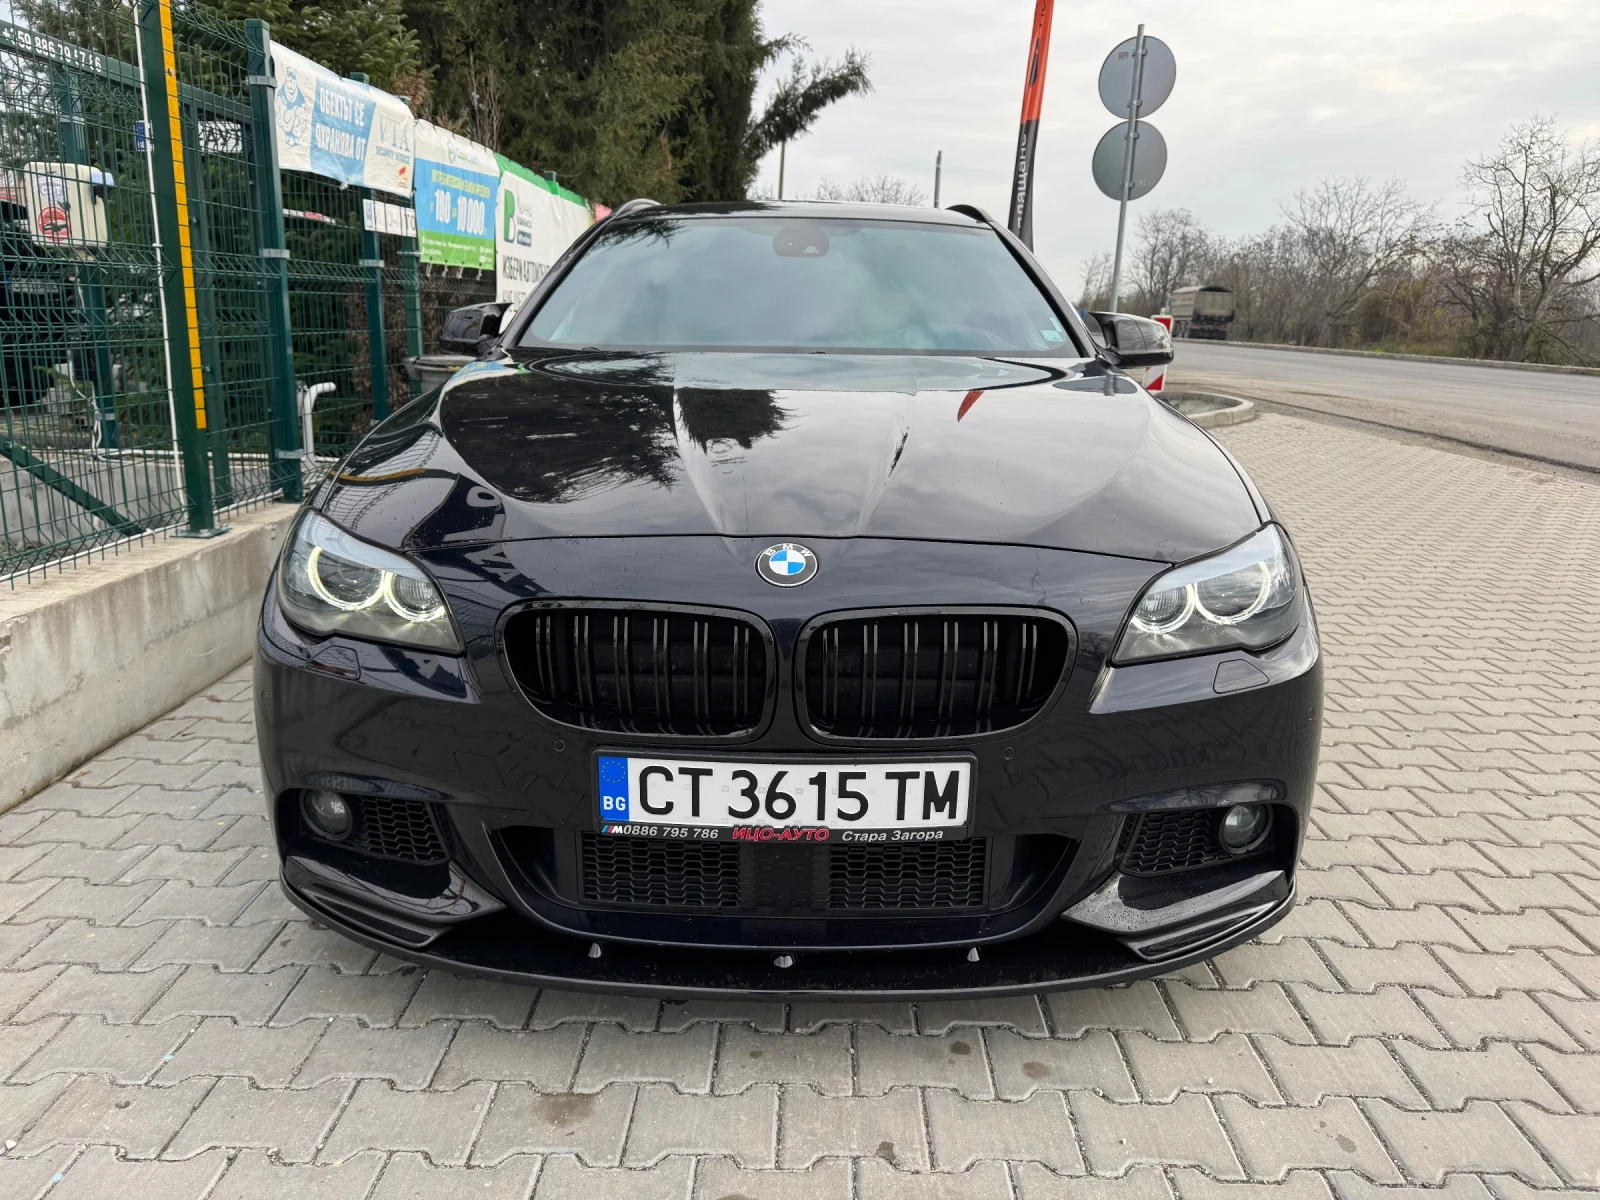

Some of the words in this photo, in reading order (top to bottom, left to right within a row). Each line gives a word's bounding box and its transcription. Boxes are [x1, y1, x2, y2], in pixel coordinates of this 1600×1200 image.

[35, 36, 56, 58] 886
[320, 87, 353, 123] ОБЕКТЪТ
[354, 101, 365, 127] СЕ
[315, 122, 355, 159] ОХРАНЯВА
[355, 136, 367, 161] ОТ
[434, 188, 451, 224] 100
[764, 543, 813, 557] BMW
[639, 766, 713, 818] CT
[728, 769, 869, 821] 3615
[885, 770, 960, 821] TM
[603, 796, 626, 811] BG
[623, 824, 658, 837] 0886
[662, 827, 689, 838] 795
[693, 828, 719, 839] 786
[731, 827, 830, 842] ИЦО-АУТО
[842, 830, 887, 843] Стара
[891, 829, 944, 841] Загора
